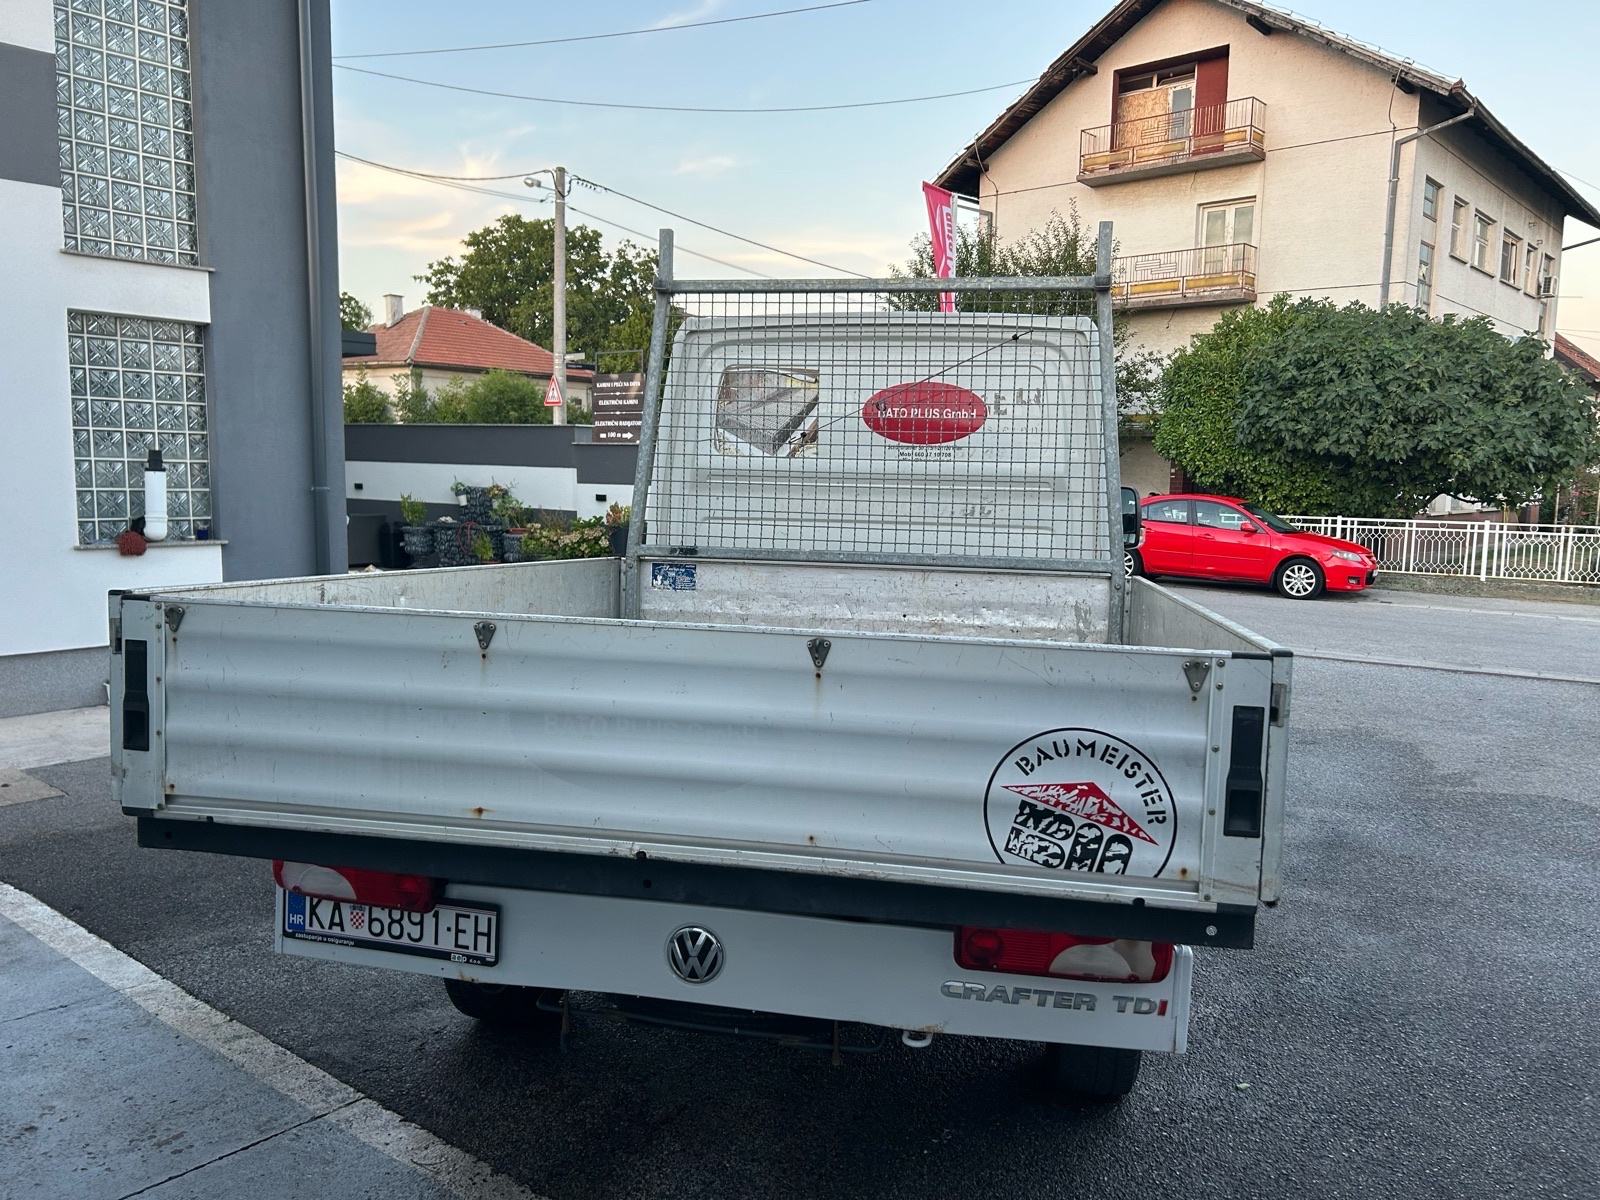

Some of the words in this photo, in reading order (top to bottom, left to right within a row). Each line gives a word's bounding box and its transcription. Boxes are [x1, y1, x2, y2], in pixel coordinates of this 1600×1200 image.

[598, 398, 622, 406] ELEKTRIČNI
[911, 408, 940, 418] PLUS
[943, 408, 976, 419] GmbH
[595, 419, 618, 427] ELEKTRIČNI
[1014, 738, 1167, 825] BAUMEISTER
[289, 914, 304, 926] HR
[308, 896, 345, 932] KA
[940, 979, 1097, 1012] CRAFTER
[1112, 995, 1168, 1017] TDI
